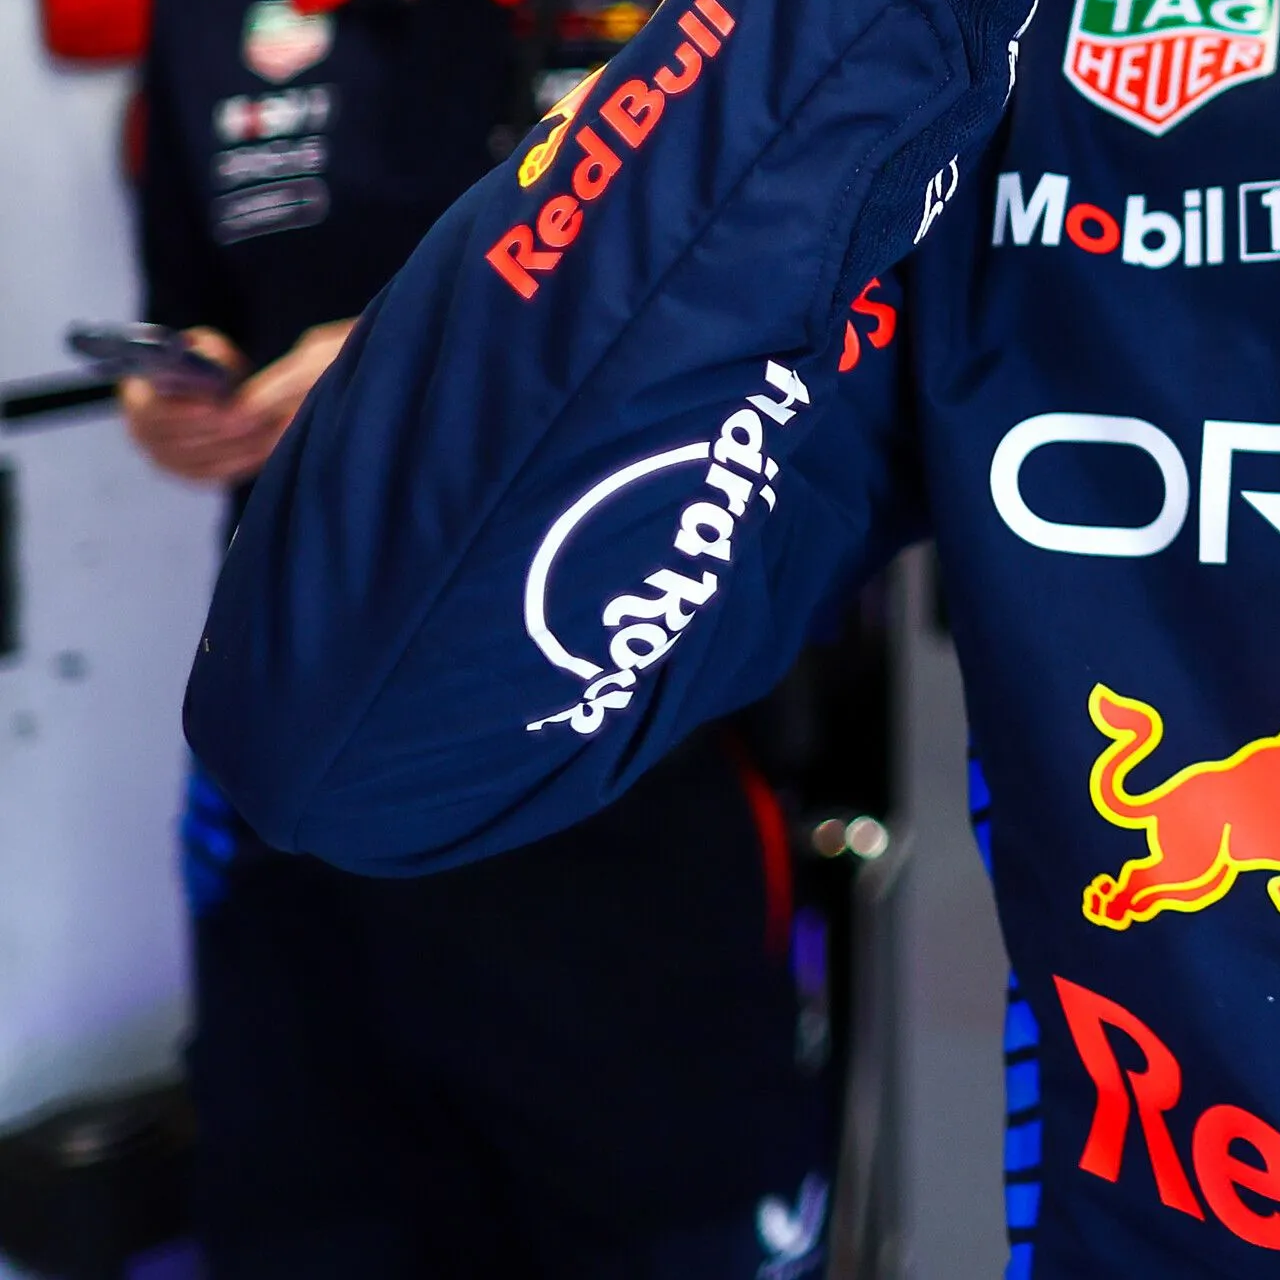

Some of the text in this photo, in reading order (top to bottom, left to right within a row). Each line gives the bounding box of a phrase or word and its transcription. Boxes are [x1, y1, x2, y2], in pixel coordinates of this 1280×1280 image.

[1075, 36, 1266, 119] HEUER
[487, 125, 622, 299] Red
[991, 172, 1224, 268] Mobil
